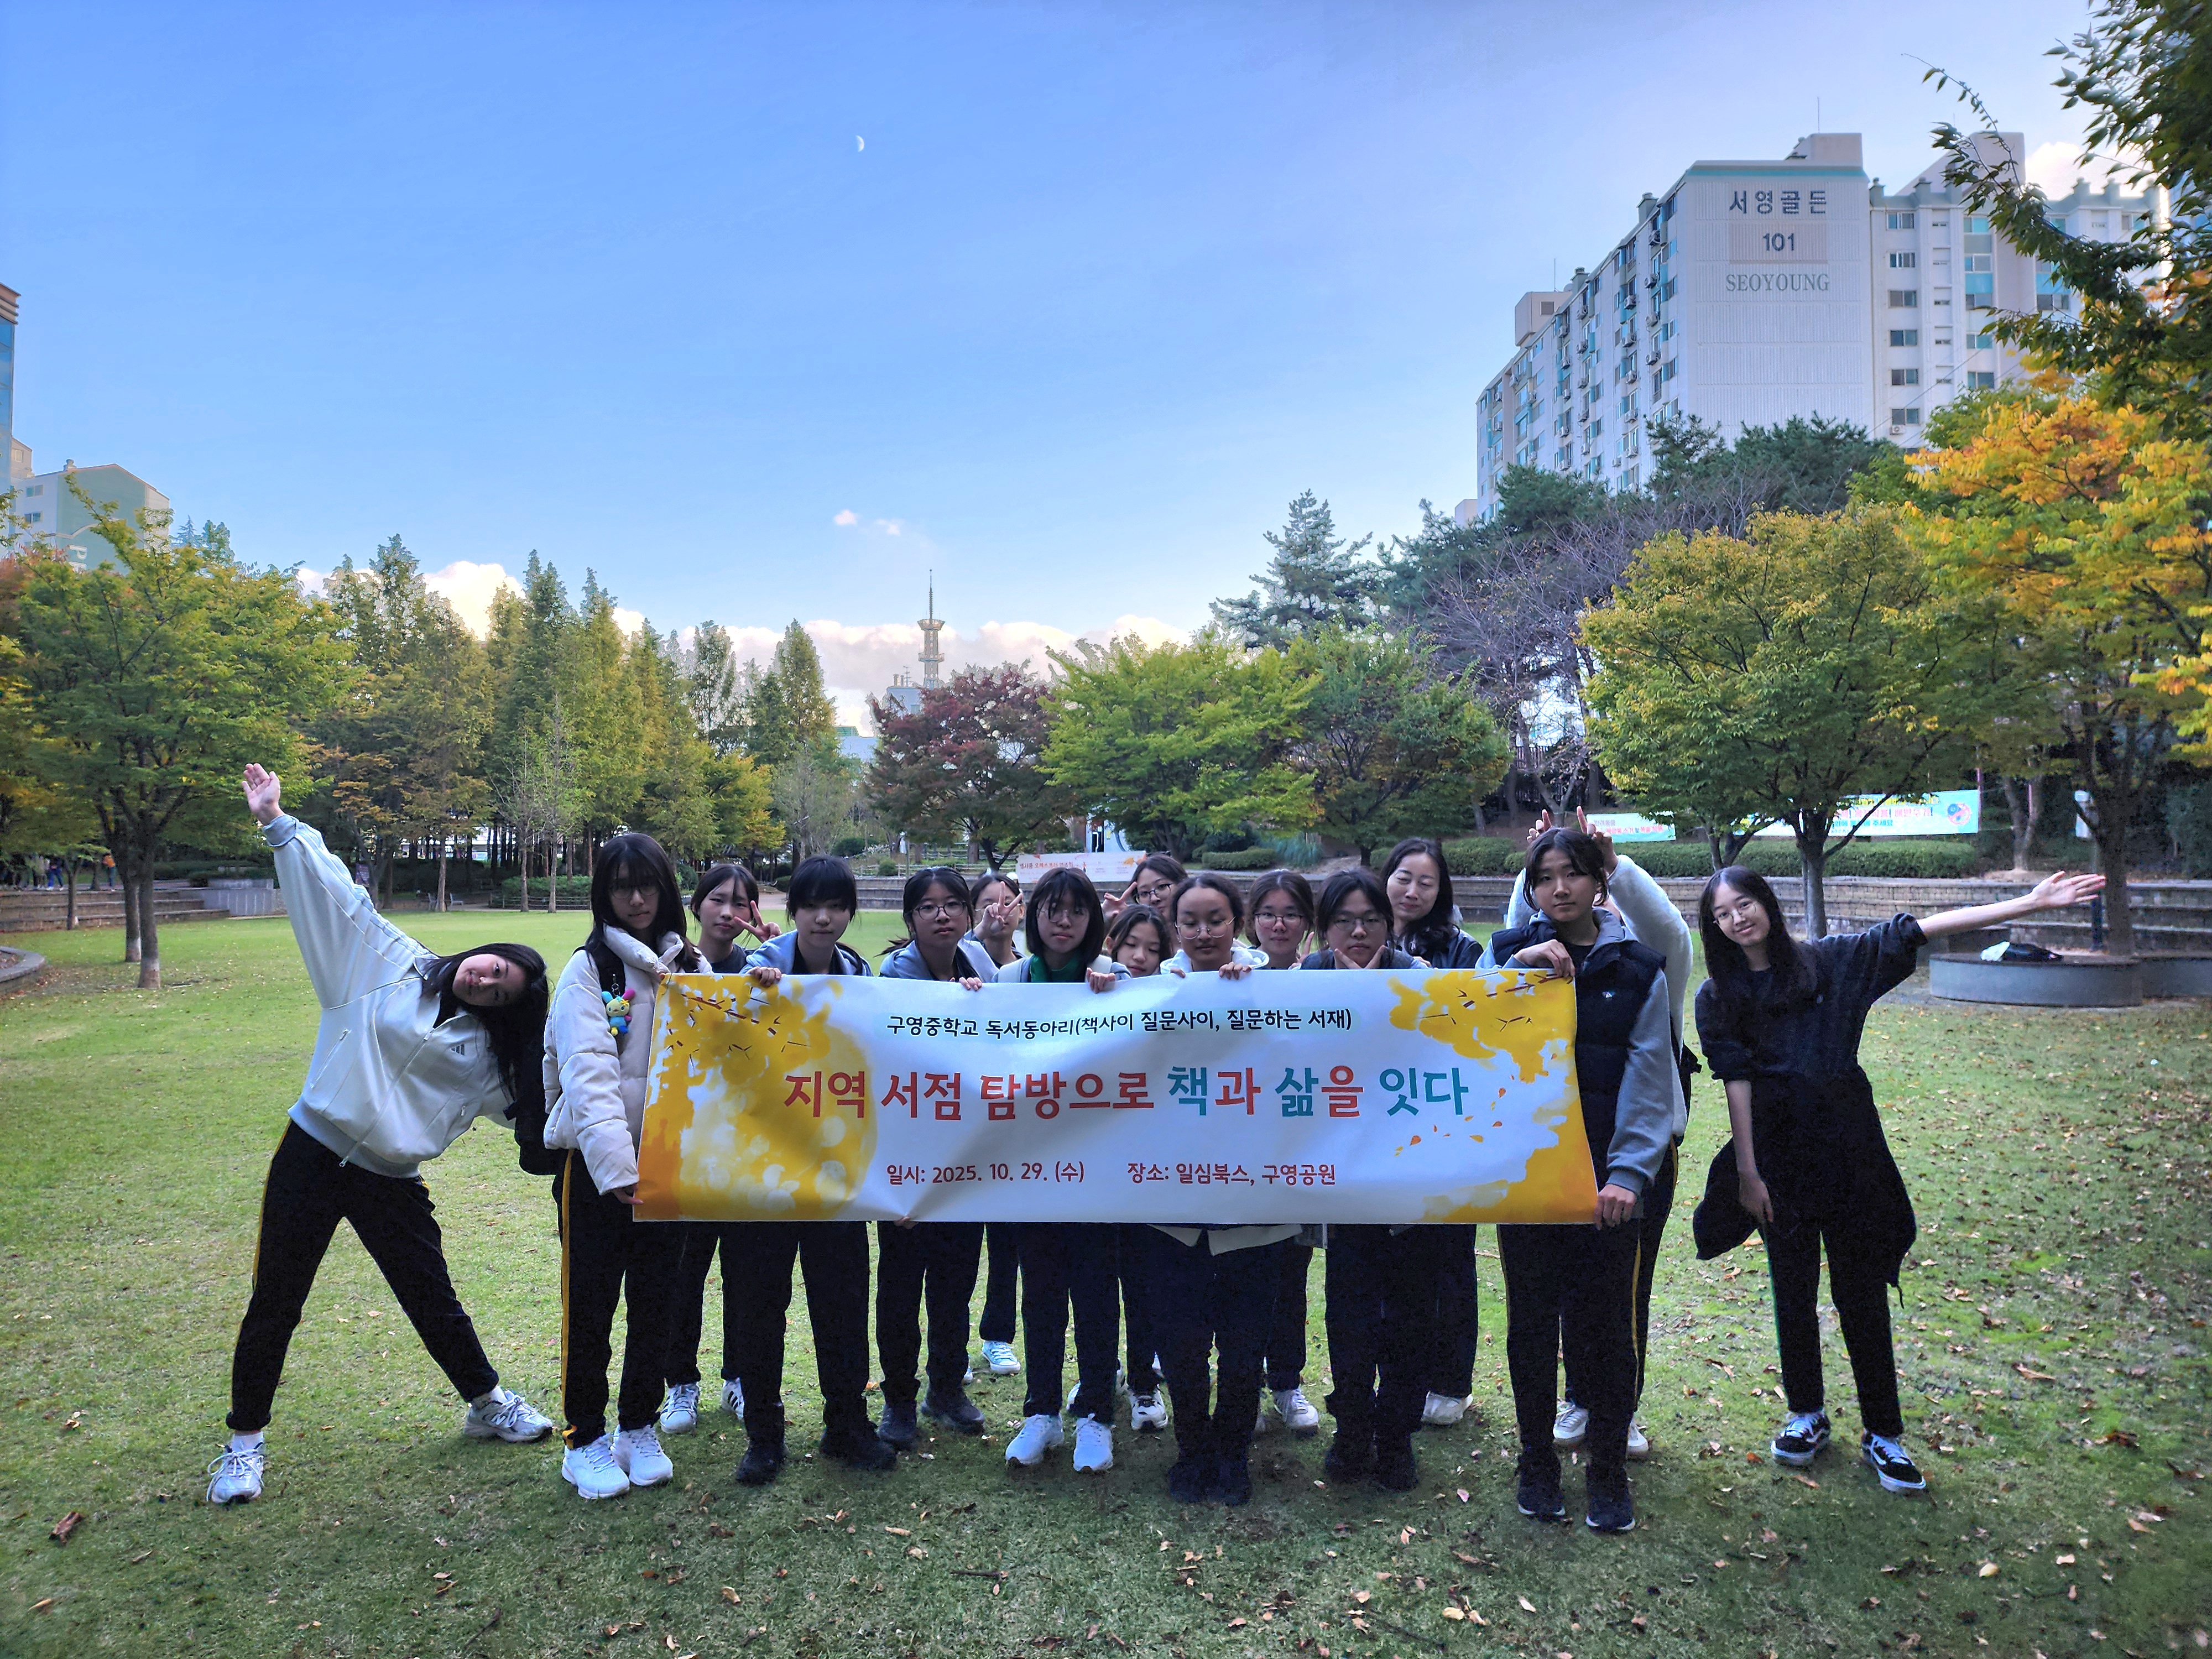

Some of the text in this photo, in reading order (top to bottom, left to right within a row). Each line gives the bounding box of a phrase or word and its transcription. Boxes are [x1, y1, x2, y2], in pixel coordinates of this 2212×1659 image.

[1729, 190, 1827, 215] 서영골든
[1762, 233, 1795, 252] 101
[1725, 273, 1830, 292] SEOYOUNG
[886, 1008, 1352, 1040] 구영중학교 독서동아리(책사이 질문사이, 질문하는 서재)
[784, 1066, 1469, 1121] 지역 서점 탐방으로 책과 삶을 잇다
[887, 1162, 1085, 1185] 일시: 2025. 10. 29. (수)
[1128, 1162, 1336, 1187] 장소: 일심북스, 구영공원
